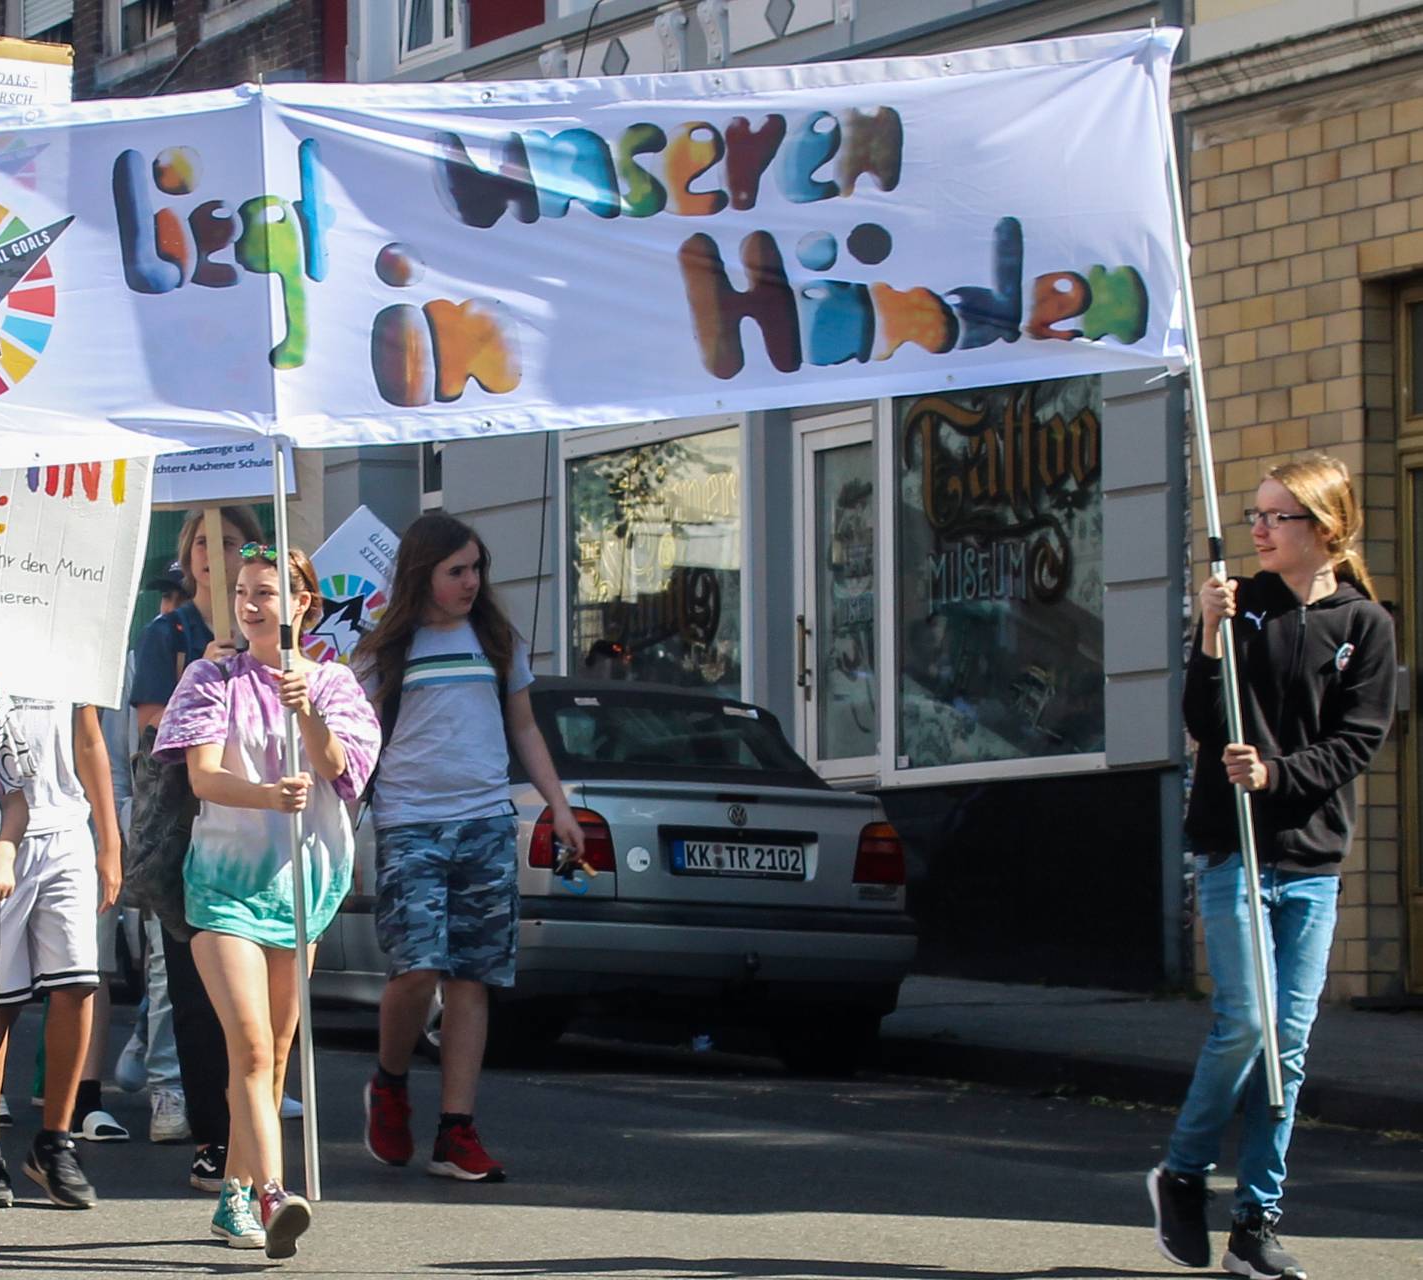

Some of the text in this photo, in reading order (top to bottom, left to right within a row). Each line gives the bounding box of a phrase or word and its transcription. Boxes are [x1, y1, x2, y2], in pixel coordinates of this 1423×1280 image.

[434, 105, 904, 229] unseren
[11, 230, 51, 257] GOALS
[371, 216, 1149, 407] in Händen
[235, 443, 255, 452] und
[903, 393, 1101, 528] Tattoo
[188, 461, 236, 472] Aachener
[20, 552, 49, 574] den
[55, 557, 105, 583] Mund
[928, 541, 1027, 605] MUSEUM
[686, 844, 801, 872] KK TR 2102
